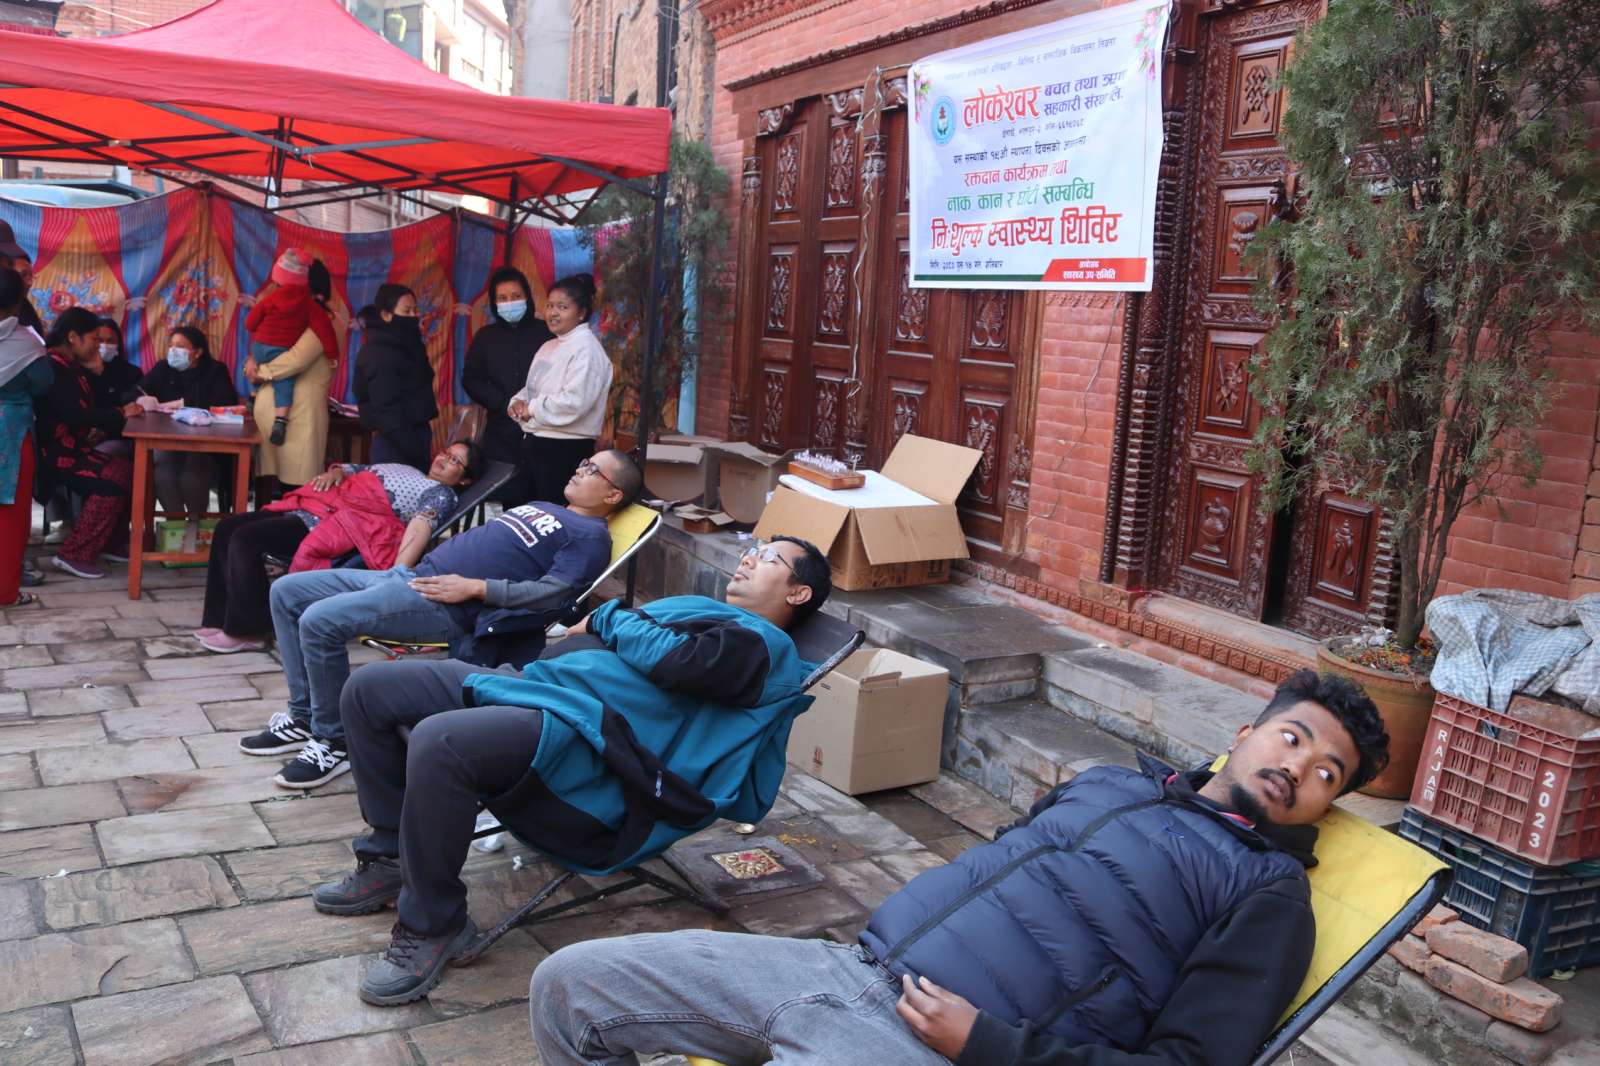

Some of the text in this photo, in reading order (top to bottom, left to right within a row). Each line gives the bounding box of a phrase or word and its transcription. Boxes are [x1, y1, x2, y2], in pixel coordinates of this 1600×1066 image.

[1044, 81, 1071, 97] बचत
[1074, 77, 1098, 92] तथा
[964, 85, 1040, 128] लोकेश्वर
[1043, 95, 1081, 117] सहकारी
[1035, 139, 1061, 154] दिवसको
[964, 170, 1000, 187] रक्तदान
[1003, 162, 1048, 183] कार्यक्रम
[947, 195, 971, 213] नाक
[978, 192, 1003, 211] कान
[1006, 190, 1016, 209] र
[1042, 176, 1095, 205] सम्बन्धि
[988, 213, 1054, 247] स्वास्थ्य
[1060, 205, 1123, 246] शिविर
[1529, 772, 1554, 848] 2023
